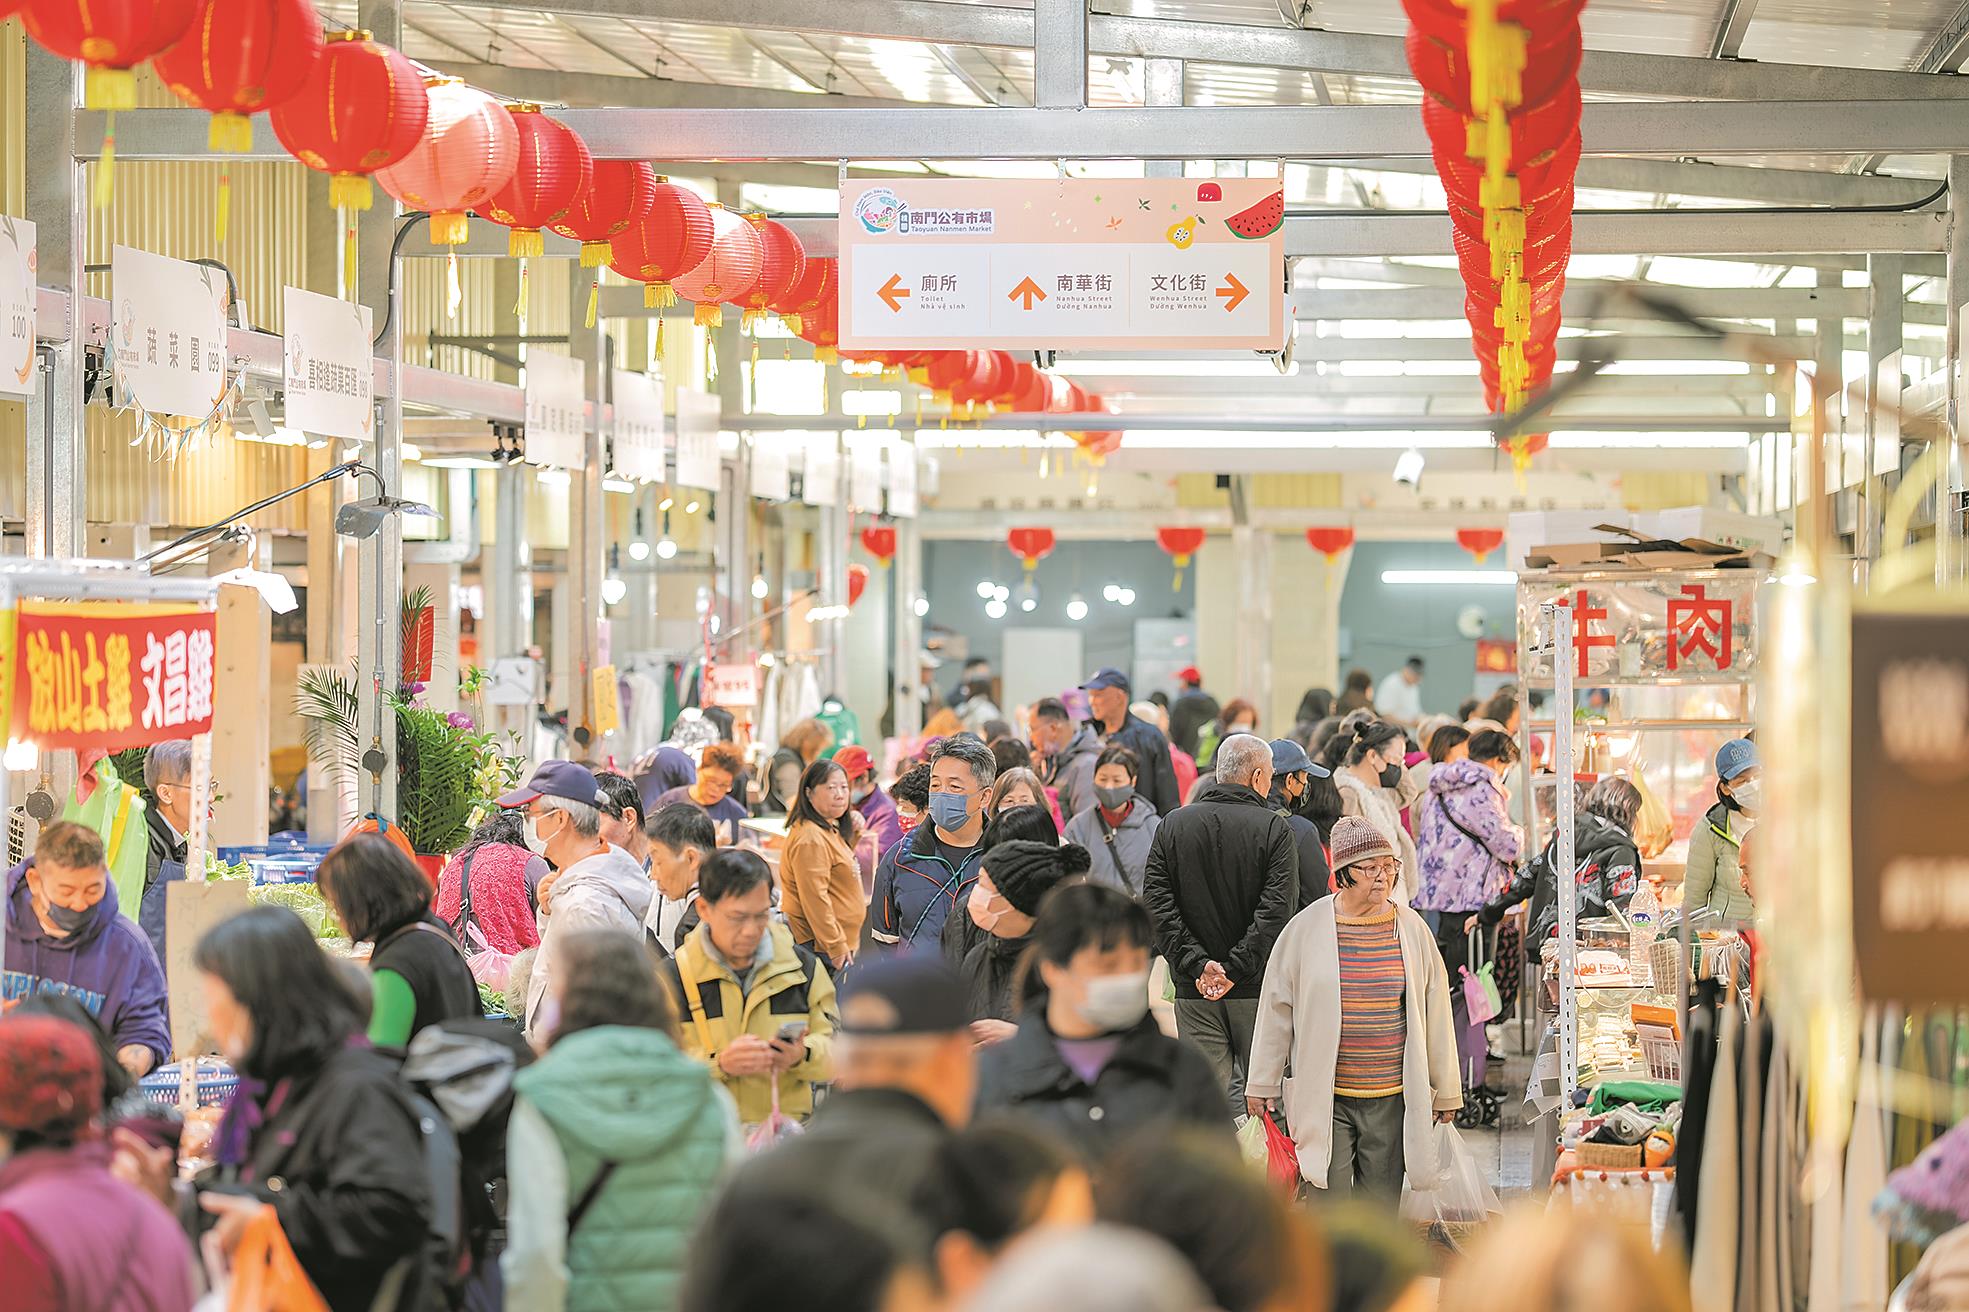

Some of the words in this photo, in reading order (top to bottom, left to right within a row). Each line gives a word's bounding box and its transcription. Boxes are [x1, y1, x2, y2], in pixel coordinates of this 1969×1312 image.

[911, 211, 993, 225] 南門公有市場
[911, 226, 939, 234] Taoyuan
[921, 274, 957, 292] 廁所
[1057, 274, 1112, 292] 南華街
[1151, 274, 1207, 291] 文化街
[12, 315, 26, 339] 100
[207, 351, 220, 373] 099
[1552, 584, 1732, 678] 牛肉
